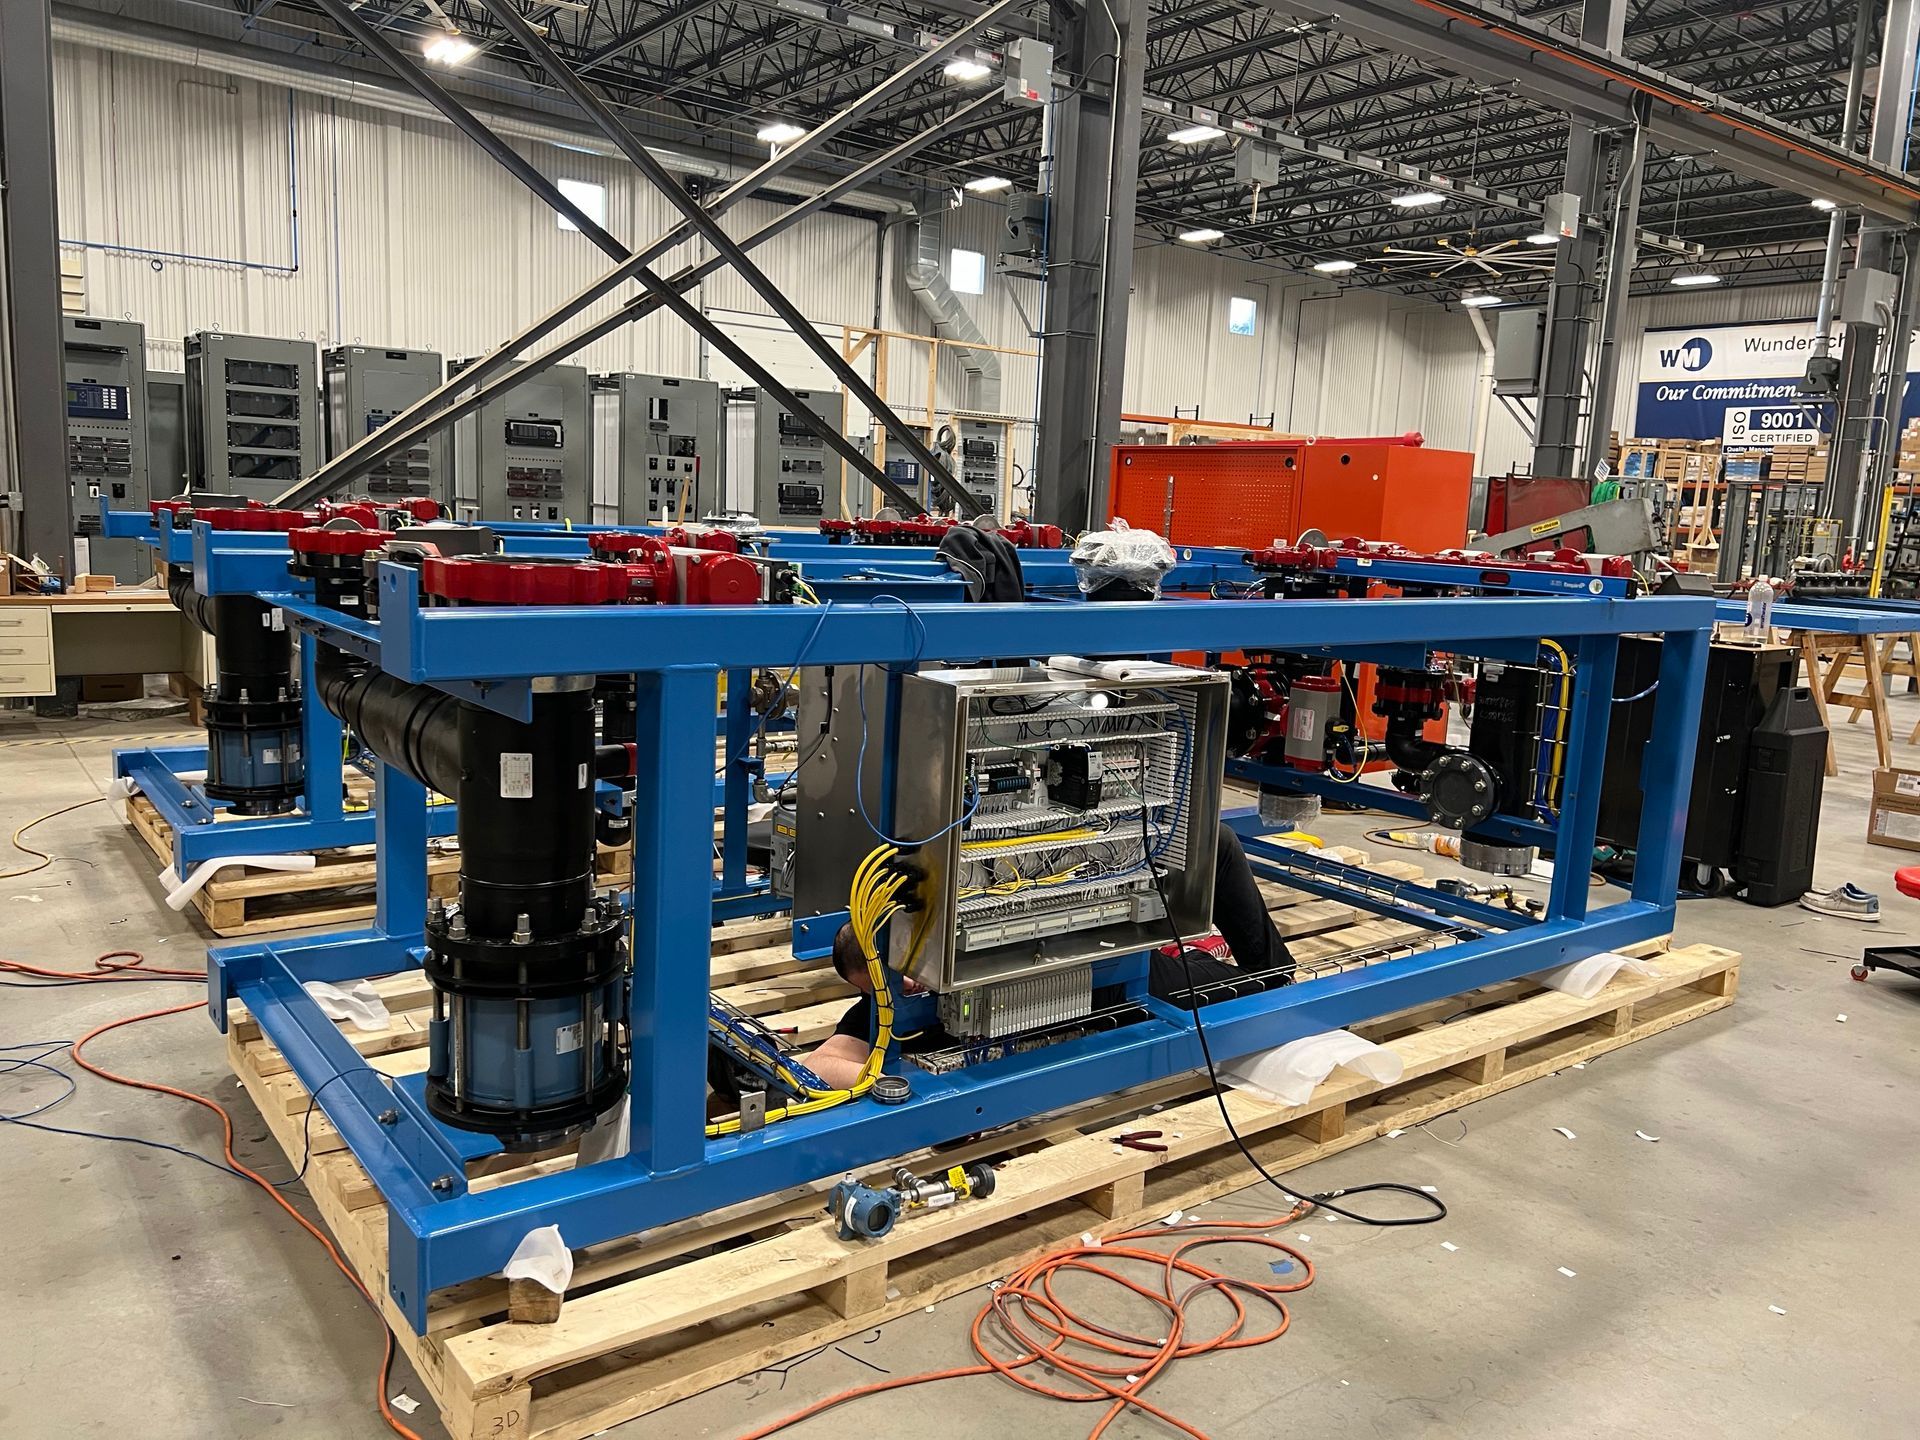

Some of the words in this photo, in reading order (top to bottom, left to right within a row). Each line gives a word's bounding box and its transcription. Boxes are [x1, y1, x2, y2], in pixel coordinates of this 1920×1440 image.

[1660, 348, 1701, 368] WM
[1656, 386, 1689, 401] Our
[1732, 411, 1747, 440] ISO
[1761, 412, 1803, 428] 9001
[1750, 433, 1813, 443] CERTIFIED
